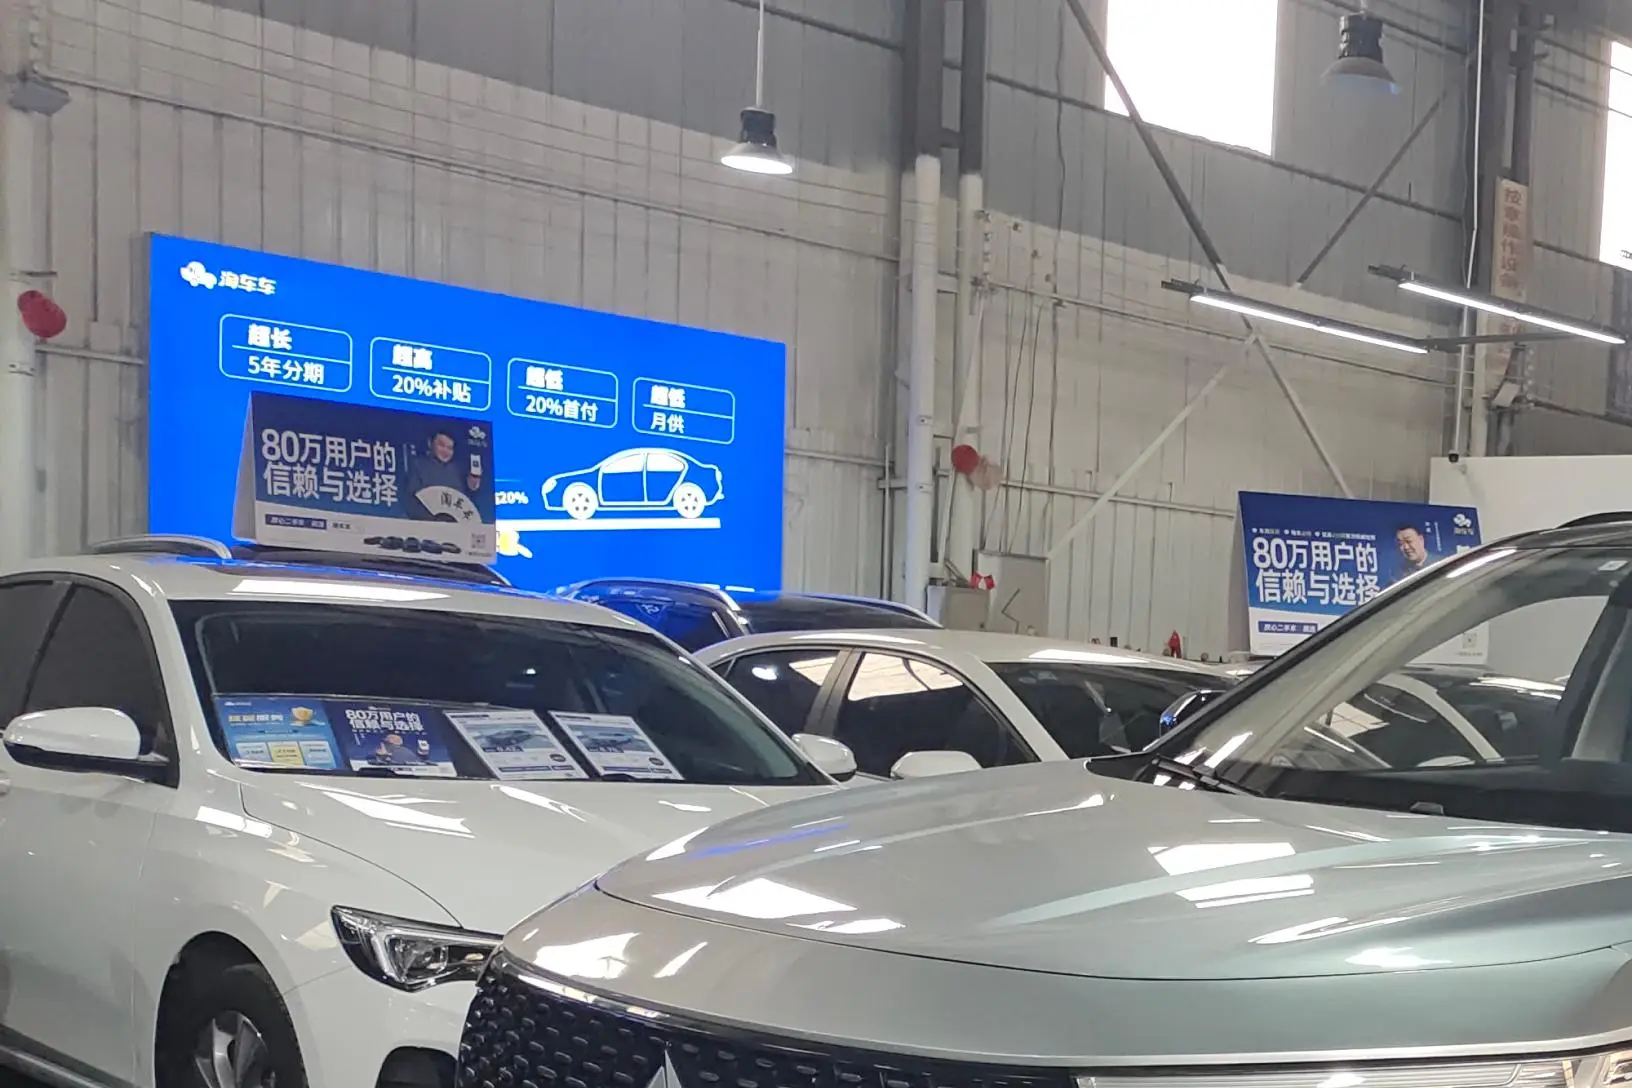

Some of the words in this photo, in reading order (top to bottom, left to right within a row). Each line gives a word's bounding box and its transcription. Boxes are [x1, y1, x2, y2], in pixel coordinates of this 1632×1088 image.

[218, 271, 276, 295] 淘车车
[248, 355, 325, 385] 5年分期
[392, 374, 472, 404] 20%补贴
[525, 394, 599, 423] 20%首付
[651, 411, 685, 434] 月供
[261, 428, 397, 473] 80万用户的
[263, 461, 399, 507] 信赖与选择
[495, 491, 529, 506] 20%
[1252, 536, 1378, 573] 80万用户的
[1255, 568, 1381, 606] 信赖与选择
